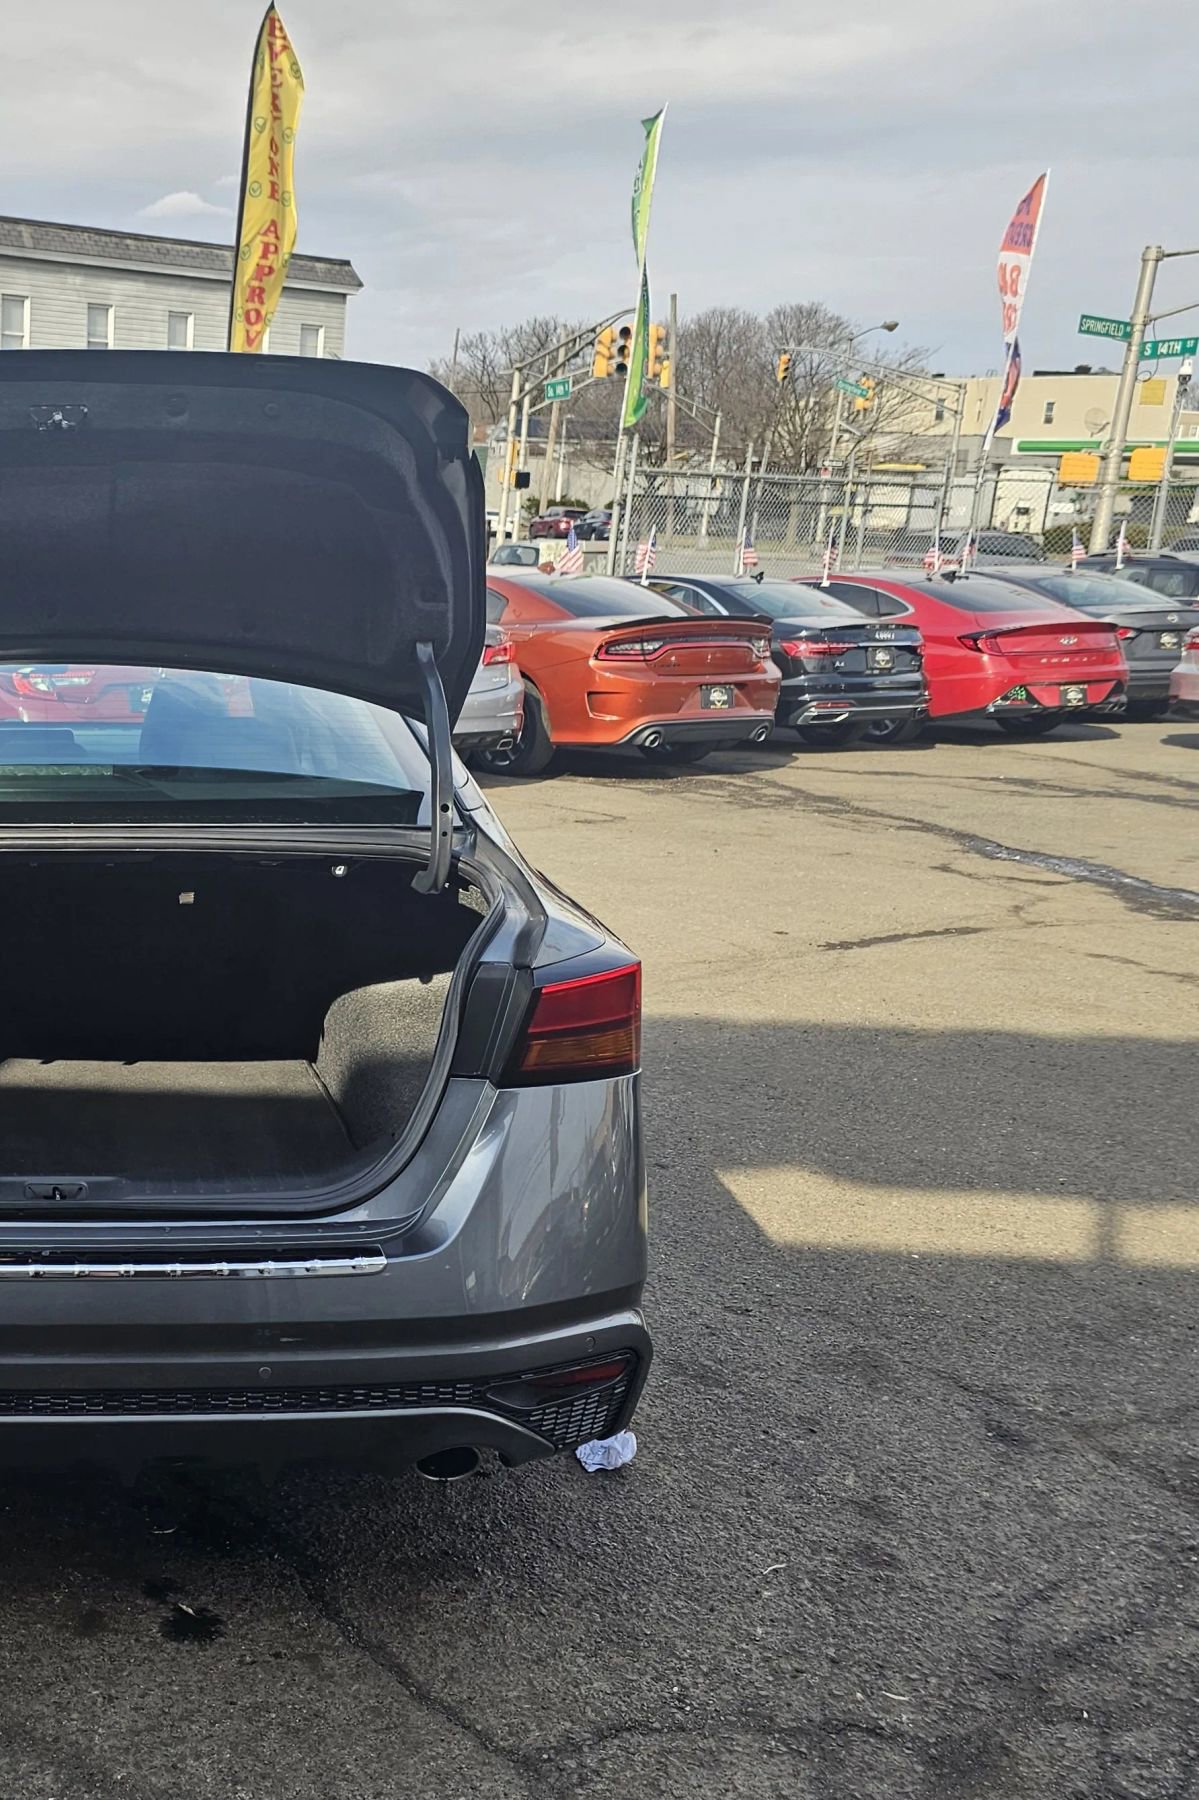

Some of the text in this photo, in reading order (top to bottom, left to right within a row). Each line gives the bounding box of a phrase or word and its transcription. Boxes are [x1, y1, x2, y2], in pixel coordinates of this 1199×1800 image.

[244, 219, 280, 347] APPROV
[1081, 318, 1123, 336] SPRINGFIELD
[1144, 343, 1152, 356] S
[1157, 341, 1182, 355] 14TH
